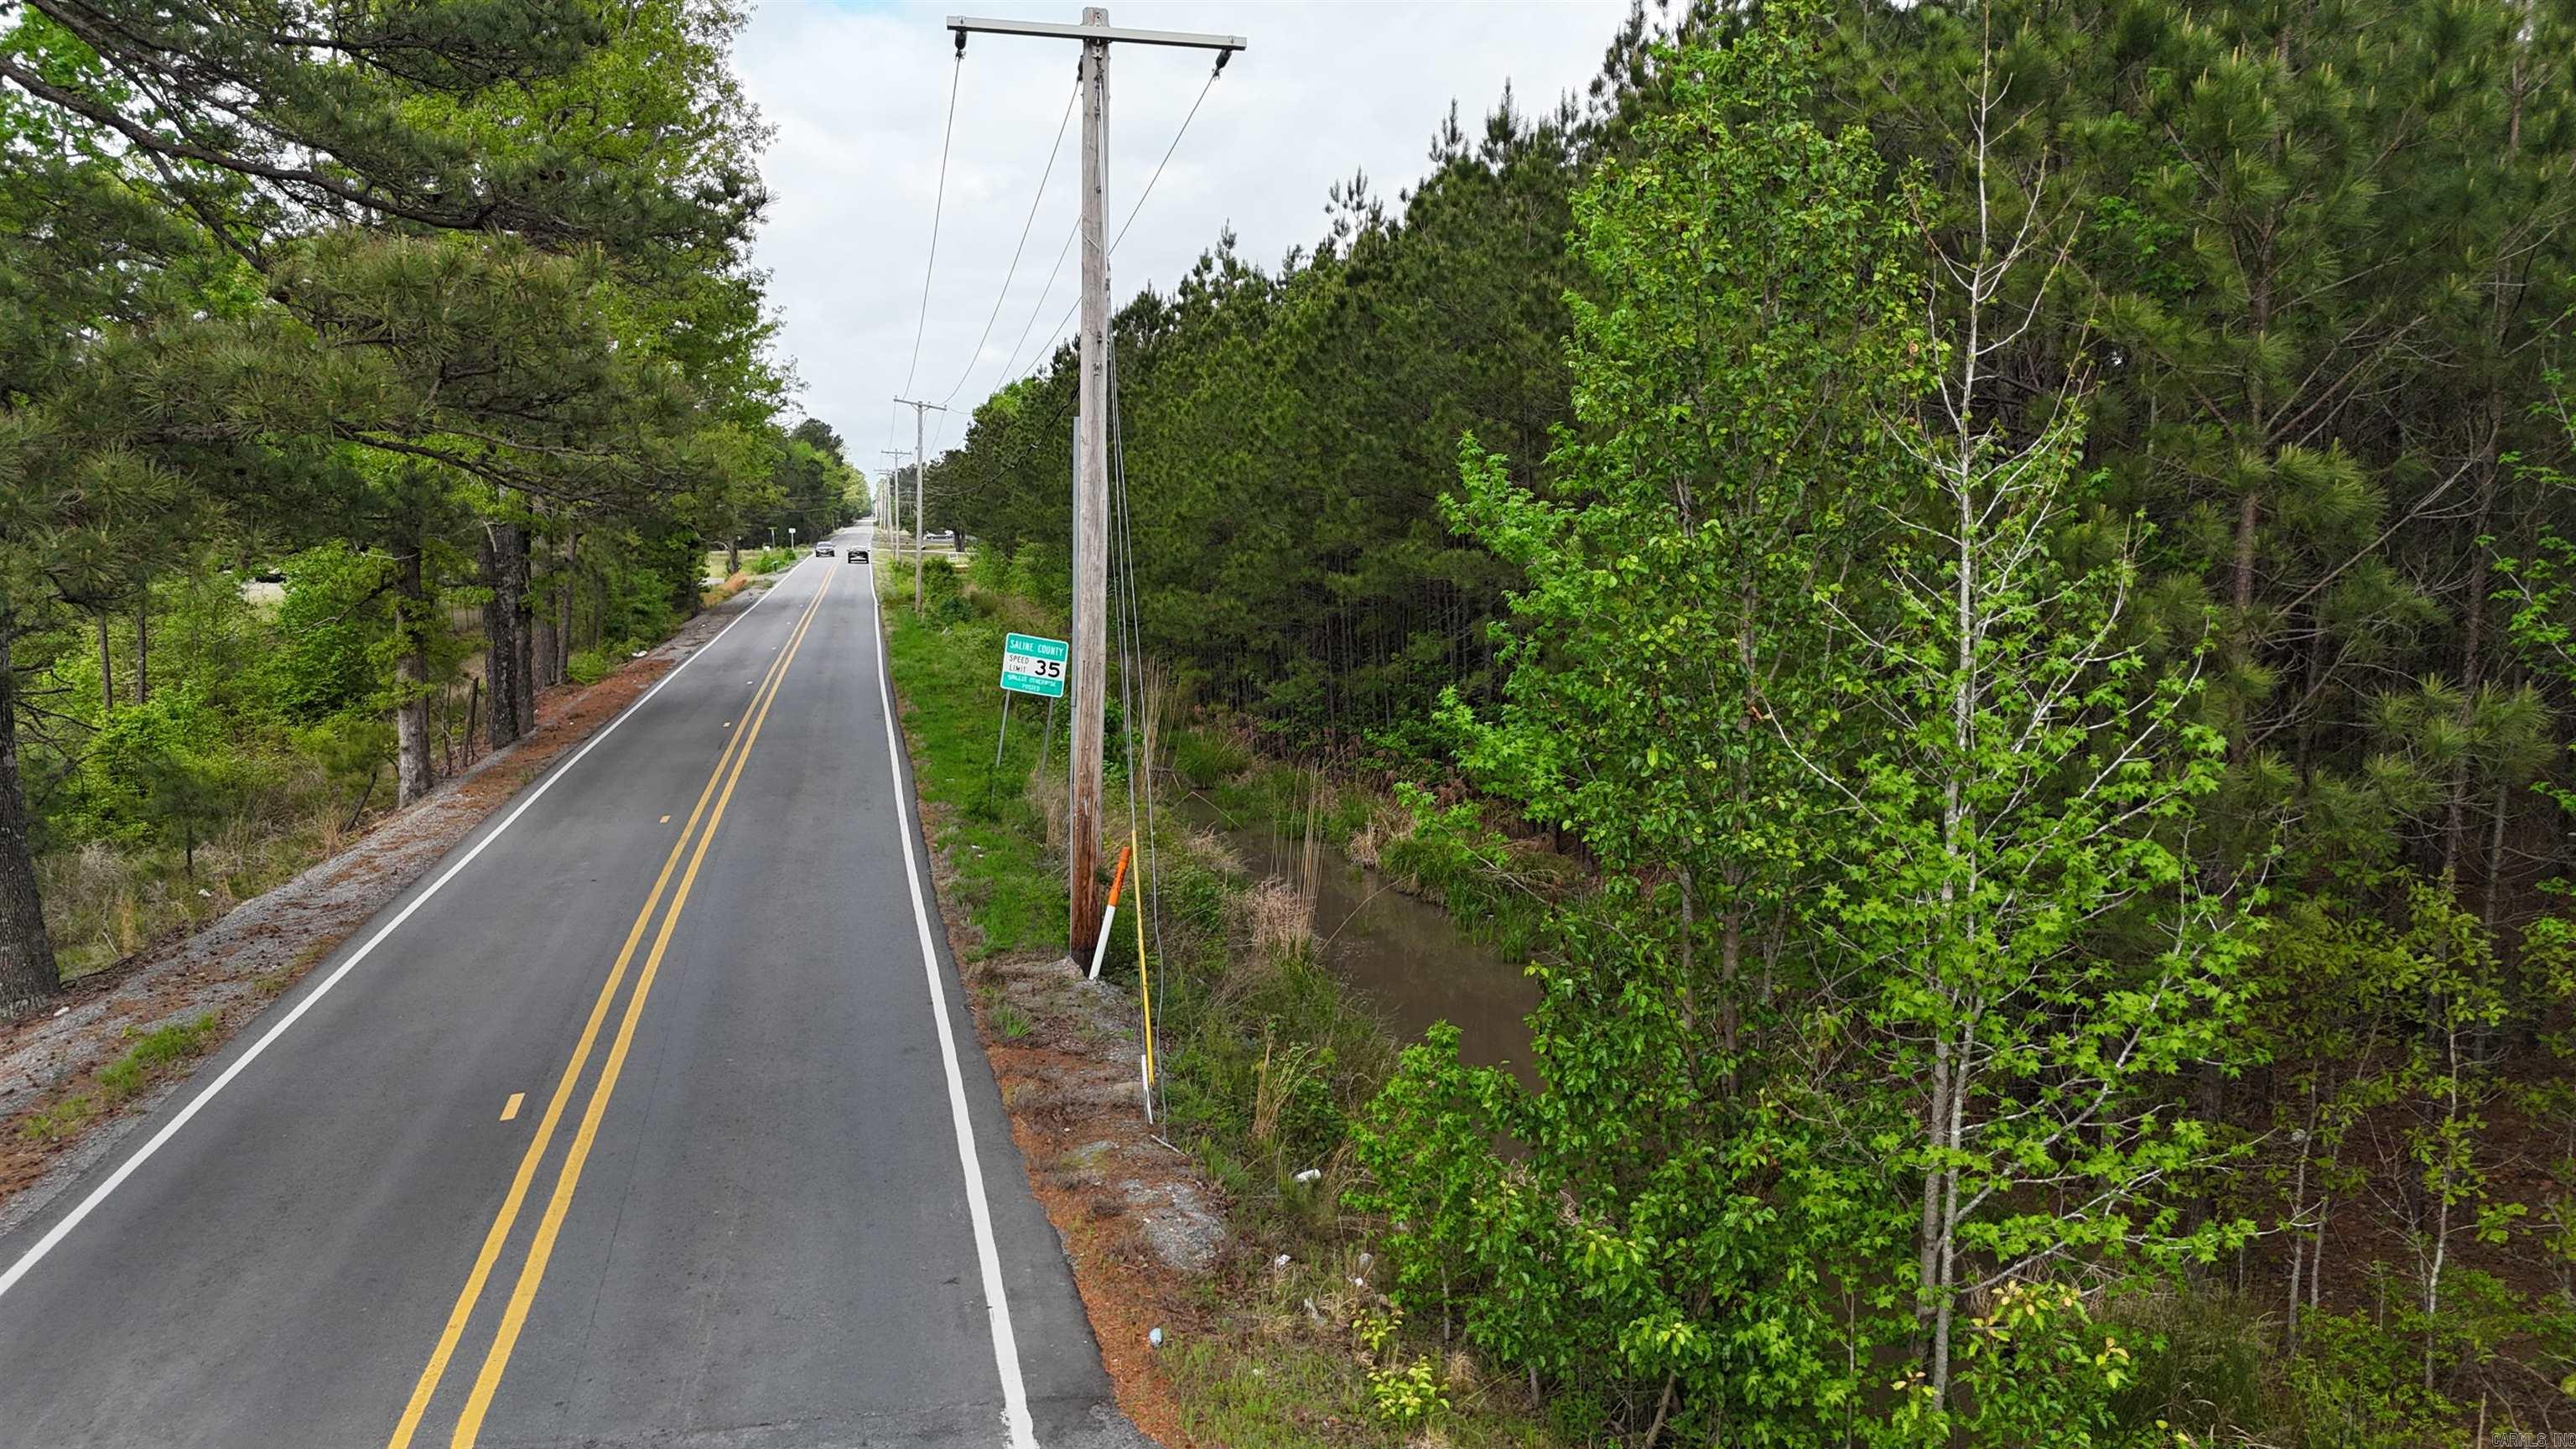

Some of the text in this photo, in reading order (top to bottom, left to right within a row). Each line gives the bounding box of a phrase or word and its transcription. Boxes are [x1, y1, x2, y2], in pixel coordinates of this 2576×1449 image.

[1010, 640, 1064, 656] SALINE COUNTY
[1009, 655, 1029, 663] SPEED
[1009, 664, 1026, 673] LIMIT
[1035, 660, 1060, 678] 35
